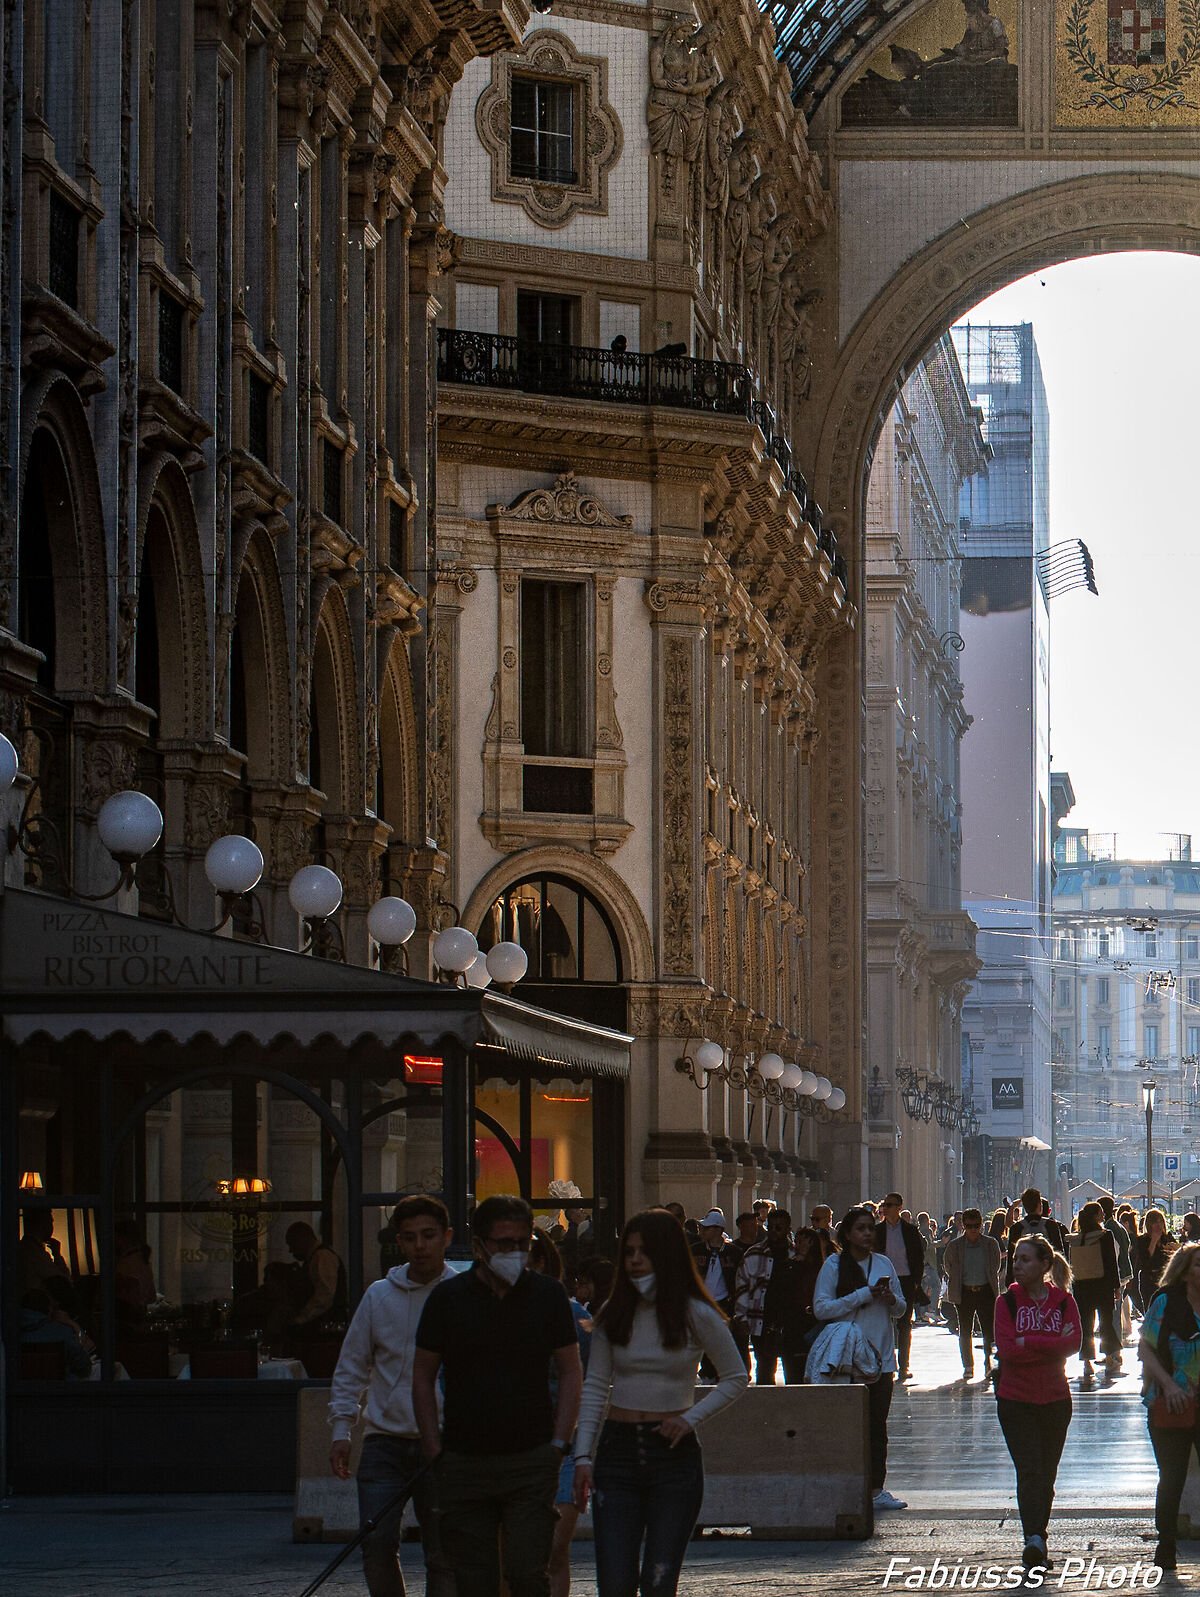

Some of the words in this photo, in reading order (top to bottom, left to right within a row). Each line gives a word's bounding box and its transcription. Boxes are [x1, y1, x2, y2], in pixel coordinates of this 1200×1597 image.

[43, 914, 109, 931] PIZZA
[73, 935, 161, 953] BISTROT
[44, 956, 272, 986] RISTORANTE
[1167, 1158, 1176, 1170] P
